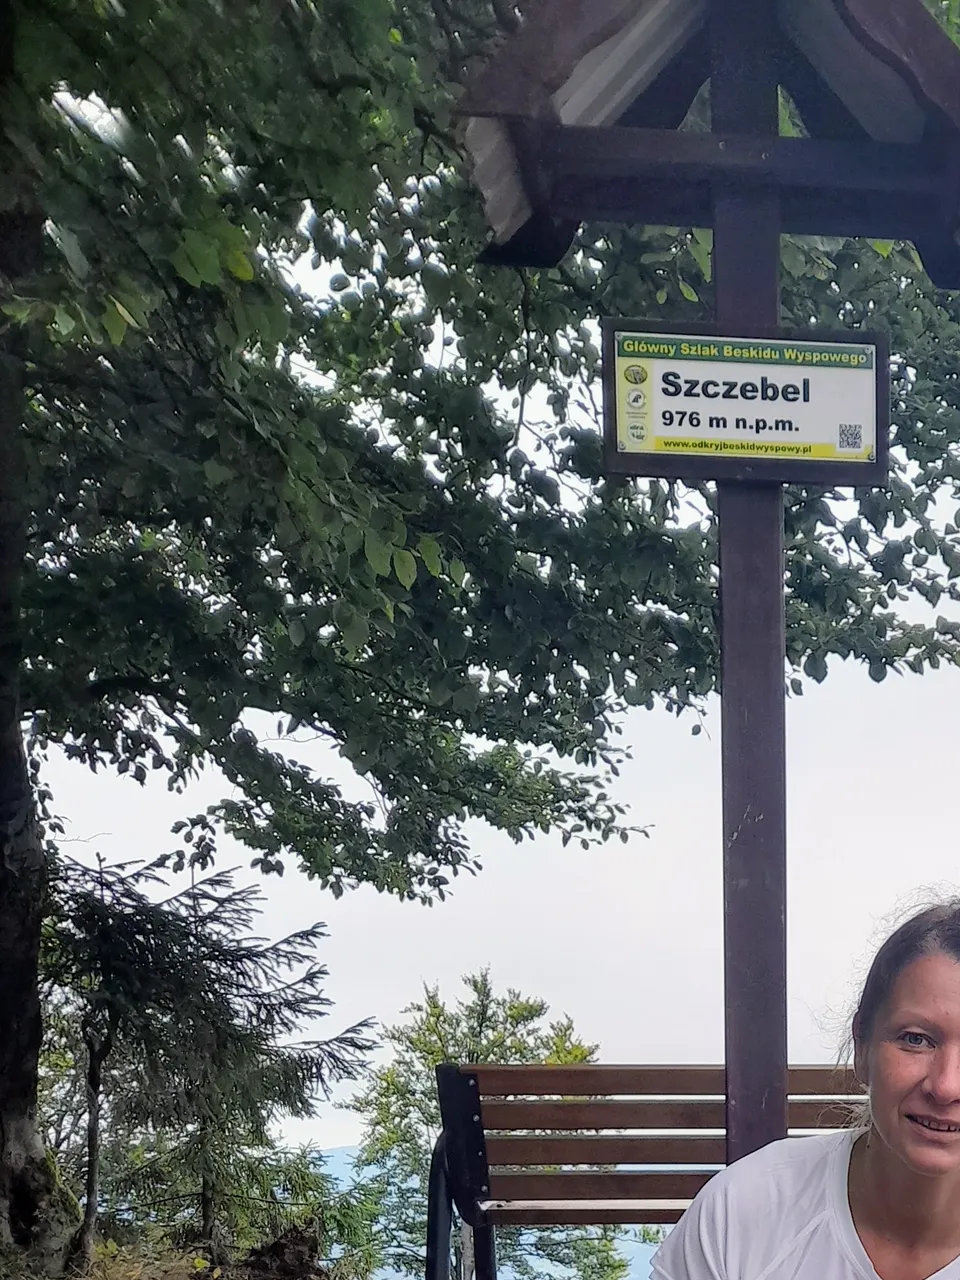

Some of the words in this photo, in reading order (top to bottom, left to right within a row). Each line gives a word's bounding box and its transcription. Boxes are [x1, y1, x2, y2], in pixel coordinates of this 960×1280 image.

[623, 340, 676, 356] Główny
[680, 343, 719, 356] Szlak
[723, 345, 779, 359] Beskidu
[783, 348, 867, 365] Wyspowego
[661, 371, 810, 402] Szczebel
[661, 410, 701, 428] 976
[708, 415, 727, 429] m
[735, 416, 800, 434] n.p.m.
[663, 440, 812, 454] www.odkryjbeskidwyspowy.pl
